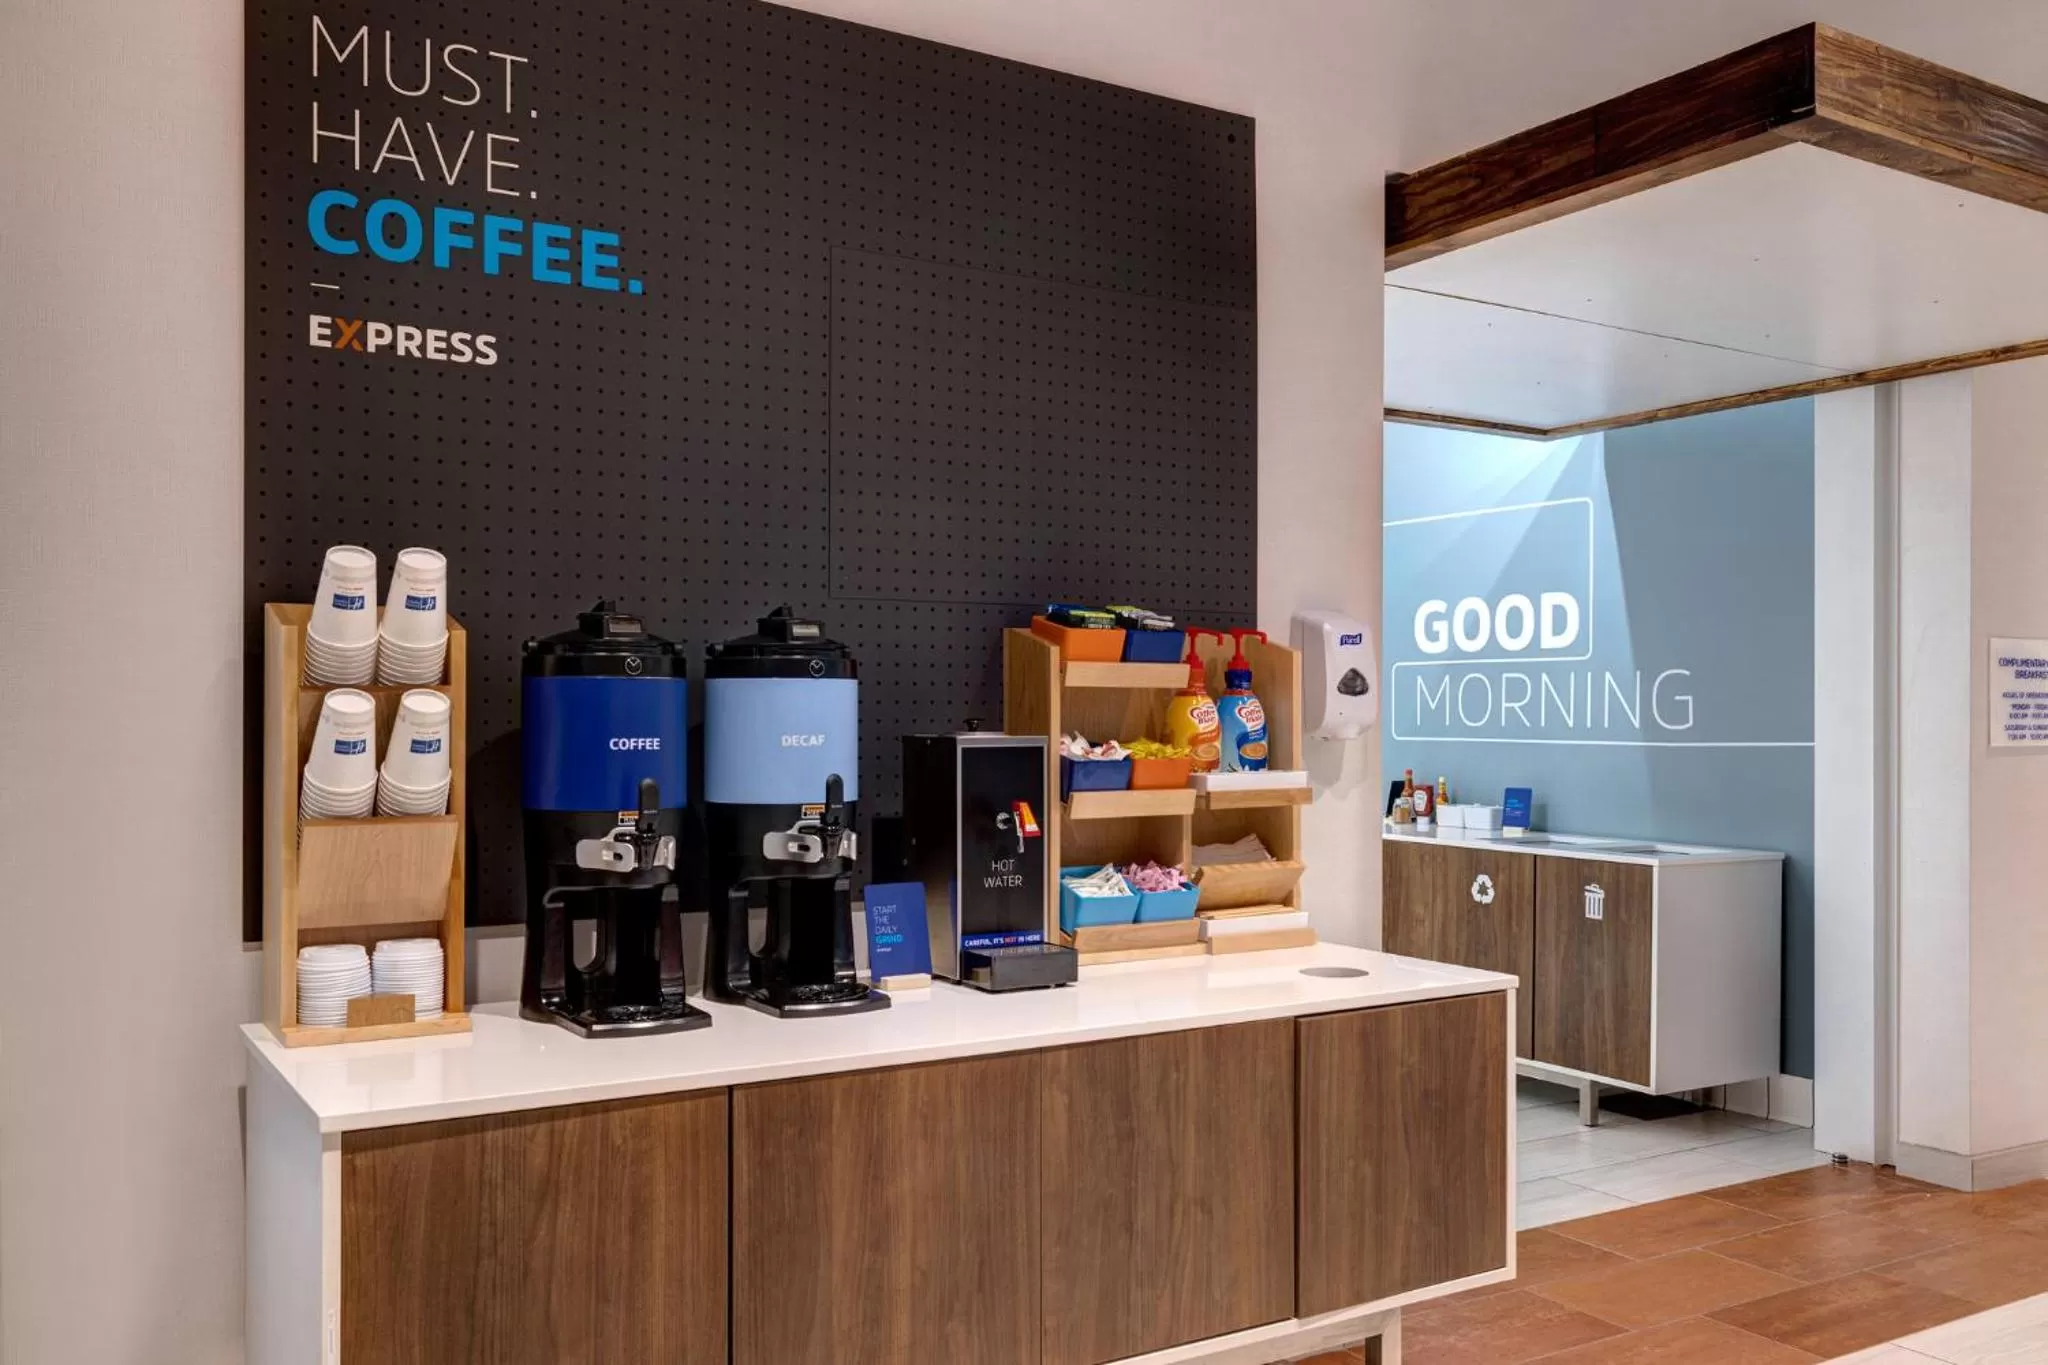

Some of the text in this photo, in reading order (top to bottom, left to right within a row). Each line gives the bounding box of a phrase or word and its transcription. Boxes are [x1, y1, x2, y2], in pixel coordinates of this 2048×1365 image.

[312, 14, 538, 118] MUST.
[312, 101, 538, 200] HAVE.
[307, 189, 644, 296] COFFEE.
[309, 314, 498, 366] EXPRESS
[1414, 591, 1581, 655] GOOD
[1415, 668, 1694, 730] MORNING
[609, 738, 661, 750] COFFEE
[781, 734, 825, 747] DECAF
[991, 859, 1015, 872] HOT
[984, 875, 1023, 888] WATER
[873, 904, 897, 915] START
[874, 916, 890, 925] THE
[875, 925, 898, 934] DAILY
